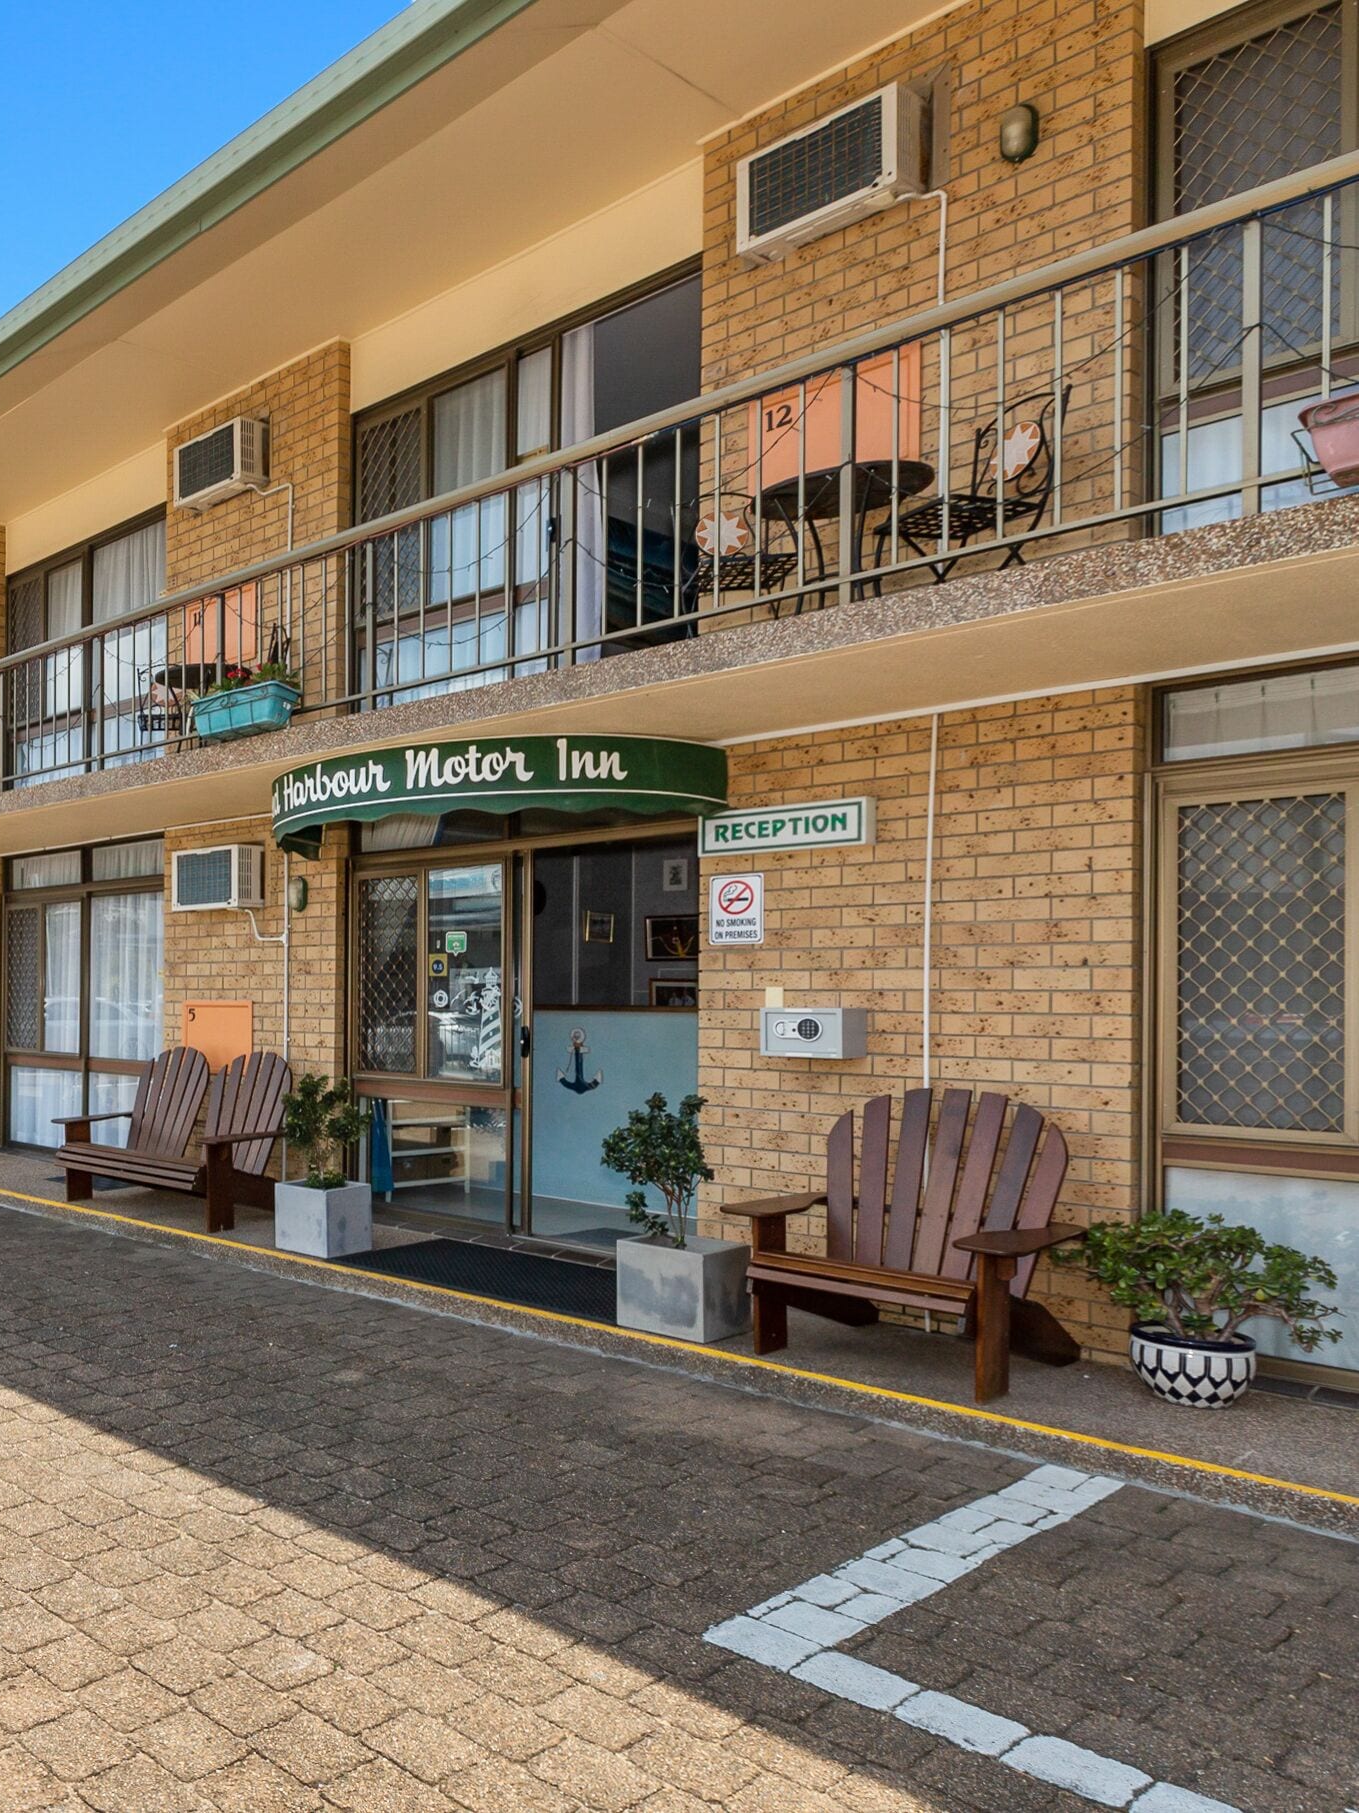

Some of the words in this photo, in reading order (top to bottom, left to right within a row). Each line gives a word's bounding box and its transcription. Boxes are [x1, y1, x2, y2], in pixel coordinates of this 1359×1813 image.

[765, 404, 793, 433] 12
[283, 759, 391, 812] Harbour
[405, 744, 535, 790] Motor
[556, 737, 628, 782] Inn
[714, 812, 848, 844] RECEPTION
[715, 919, 725, 928] NO
[726, 917, 757, 928] SMOKING
[714, 931, 724, 940] ON
[725, 929, 758, 940] PREMISES
[188, 1007, 196, 1023] 5
